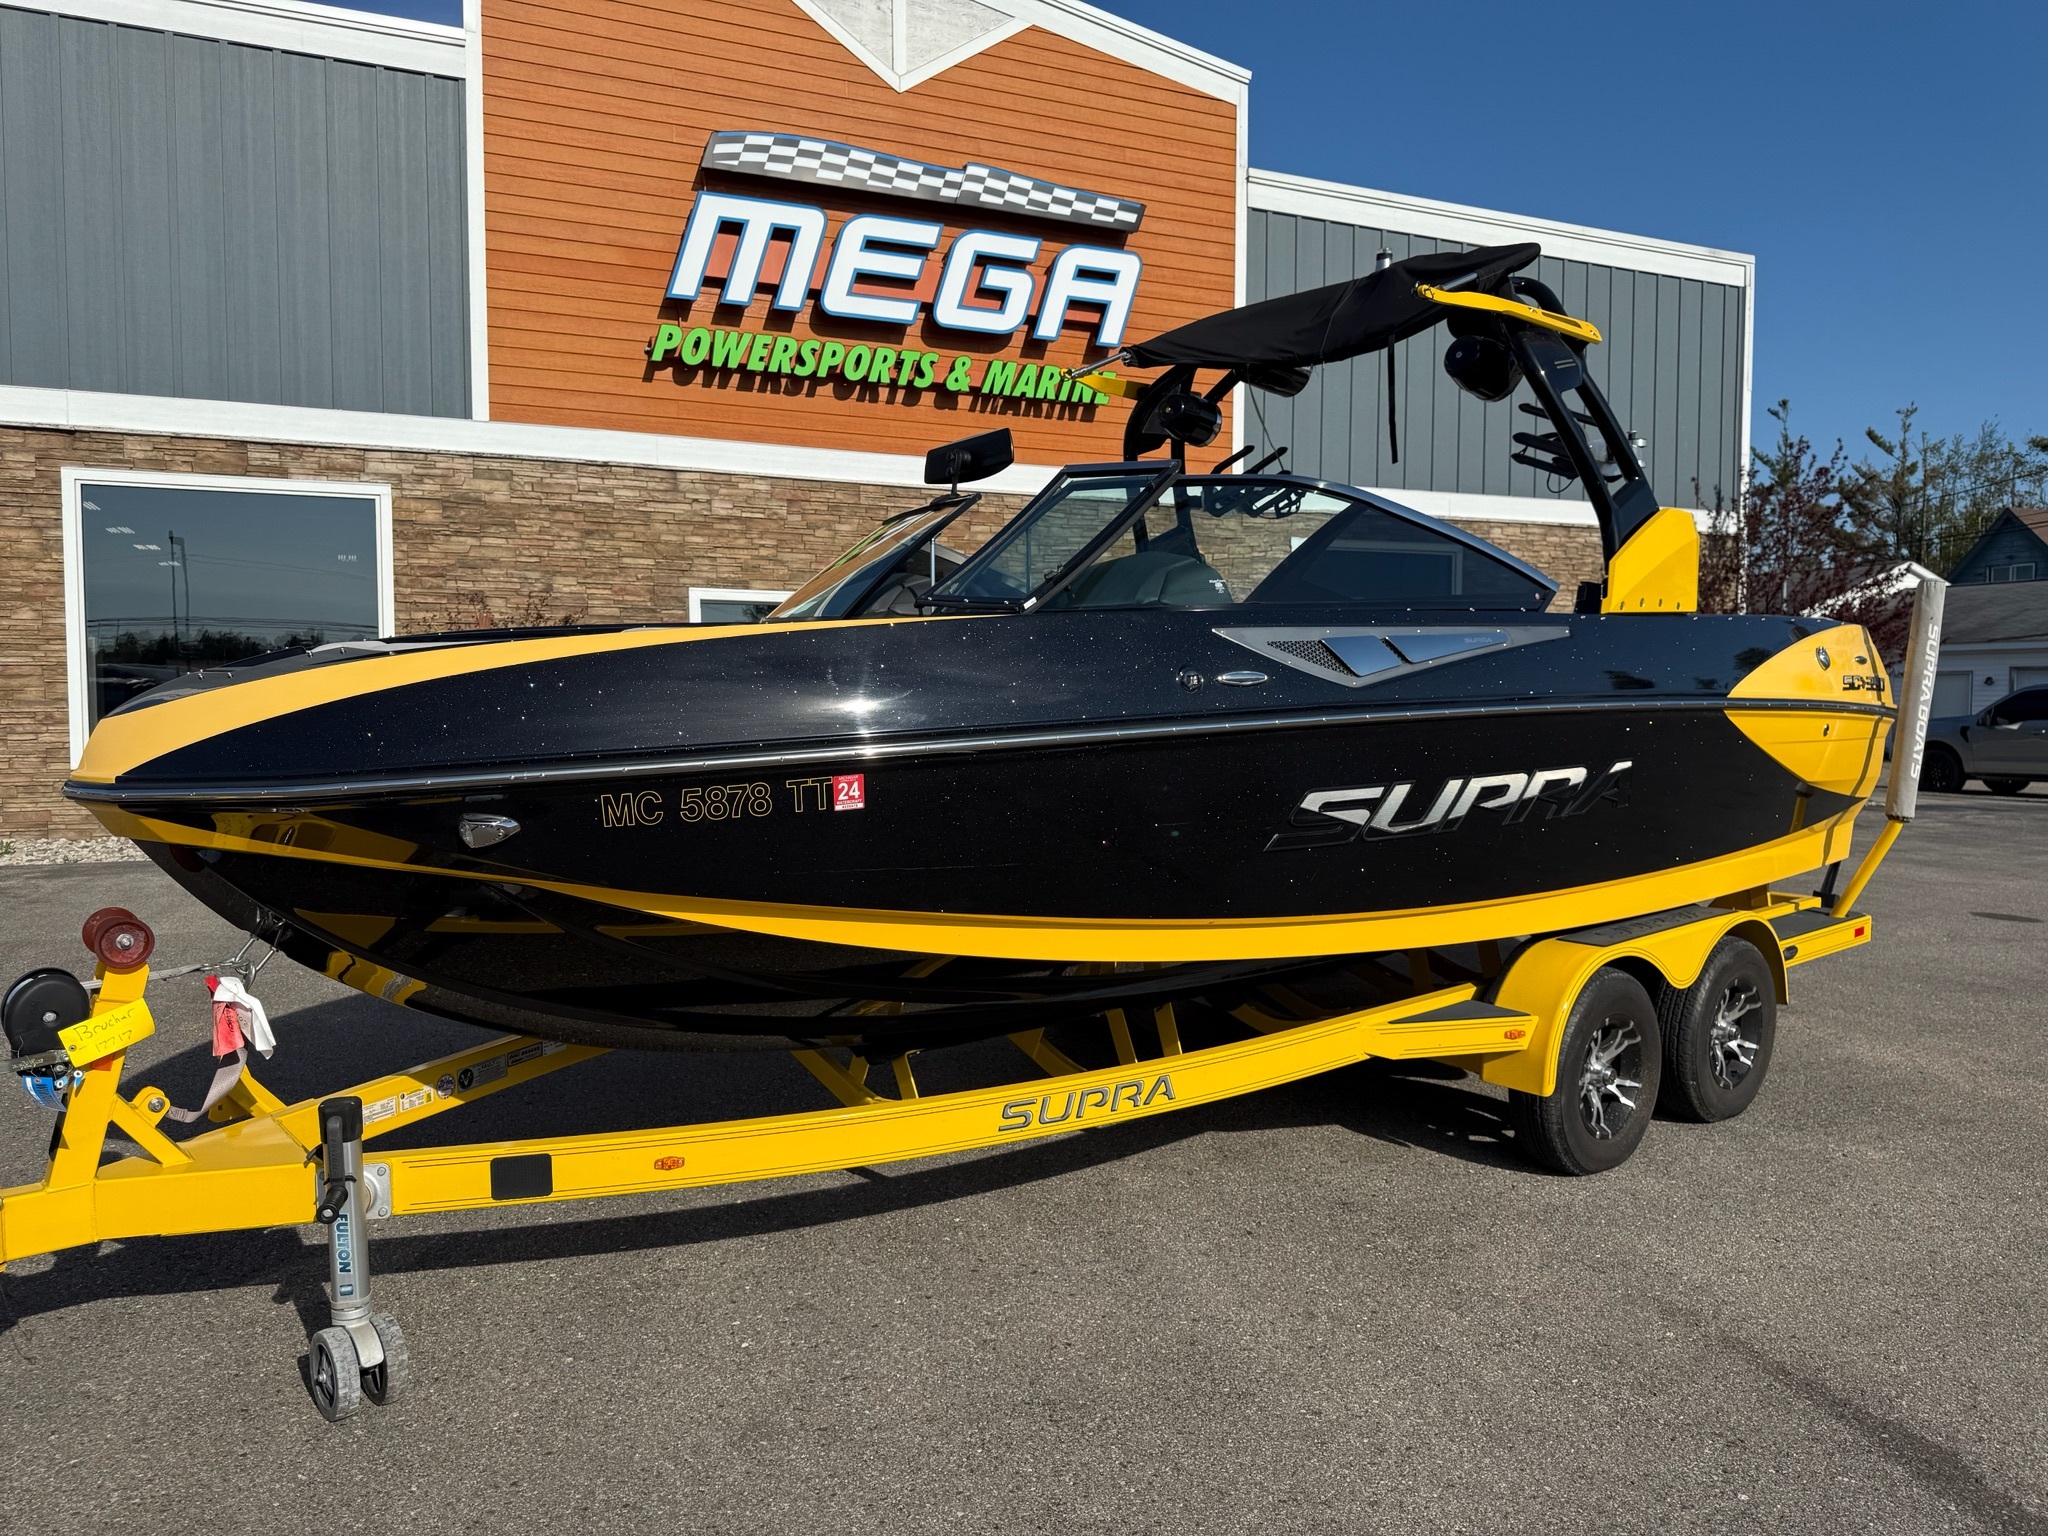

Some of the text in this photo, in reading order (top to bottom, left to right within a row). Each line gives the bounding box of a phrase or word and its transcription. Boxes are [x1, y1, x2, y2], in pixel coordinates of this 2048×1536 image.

[665, 190, 1144, 348] MEGA
[651, 324, 940, 389] POWERSPORTS
[945, 356, 973, 393] &
[1910, 624, 1939, 779] SUPRA BOATS
[600, 776, 833, 827] MC 5878 TT
[838, 781, 860, 800] 24
[1263, 757, 1634, 852] SUPRA
[997, 1074, 1176, 1131] SUPRA
[335, 1213, 352, 1274] FULTON
